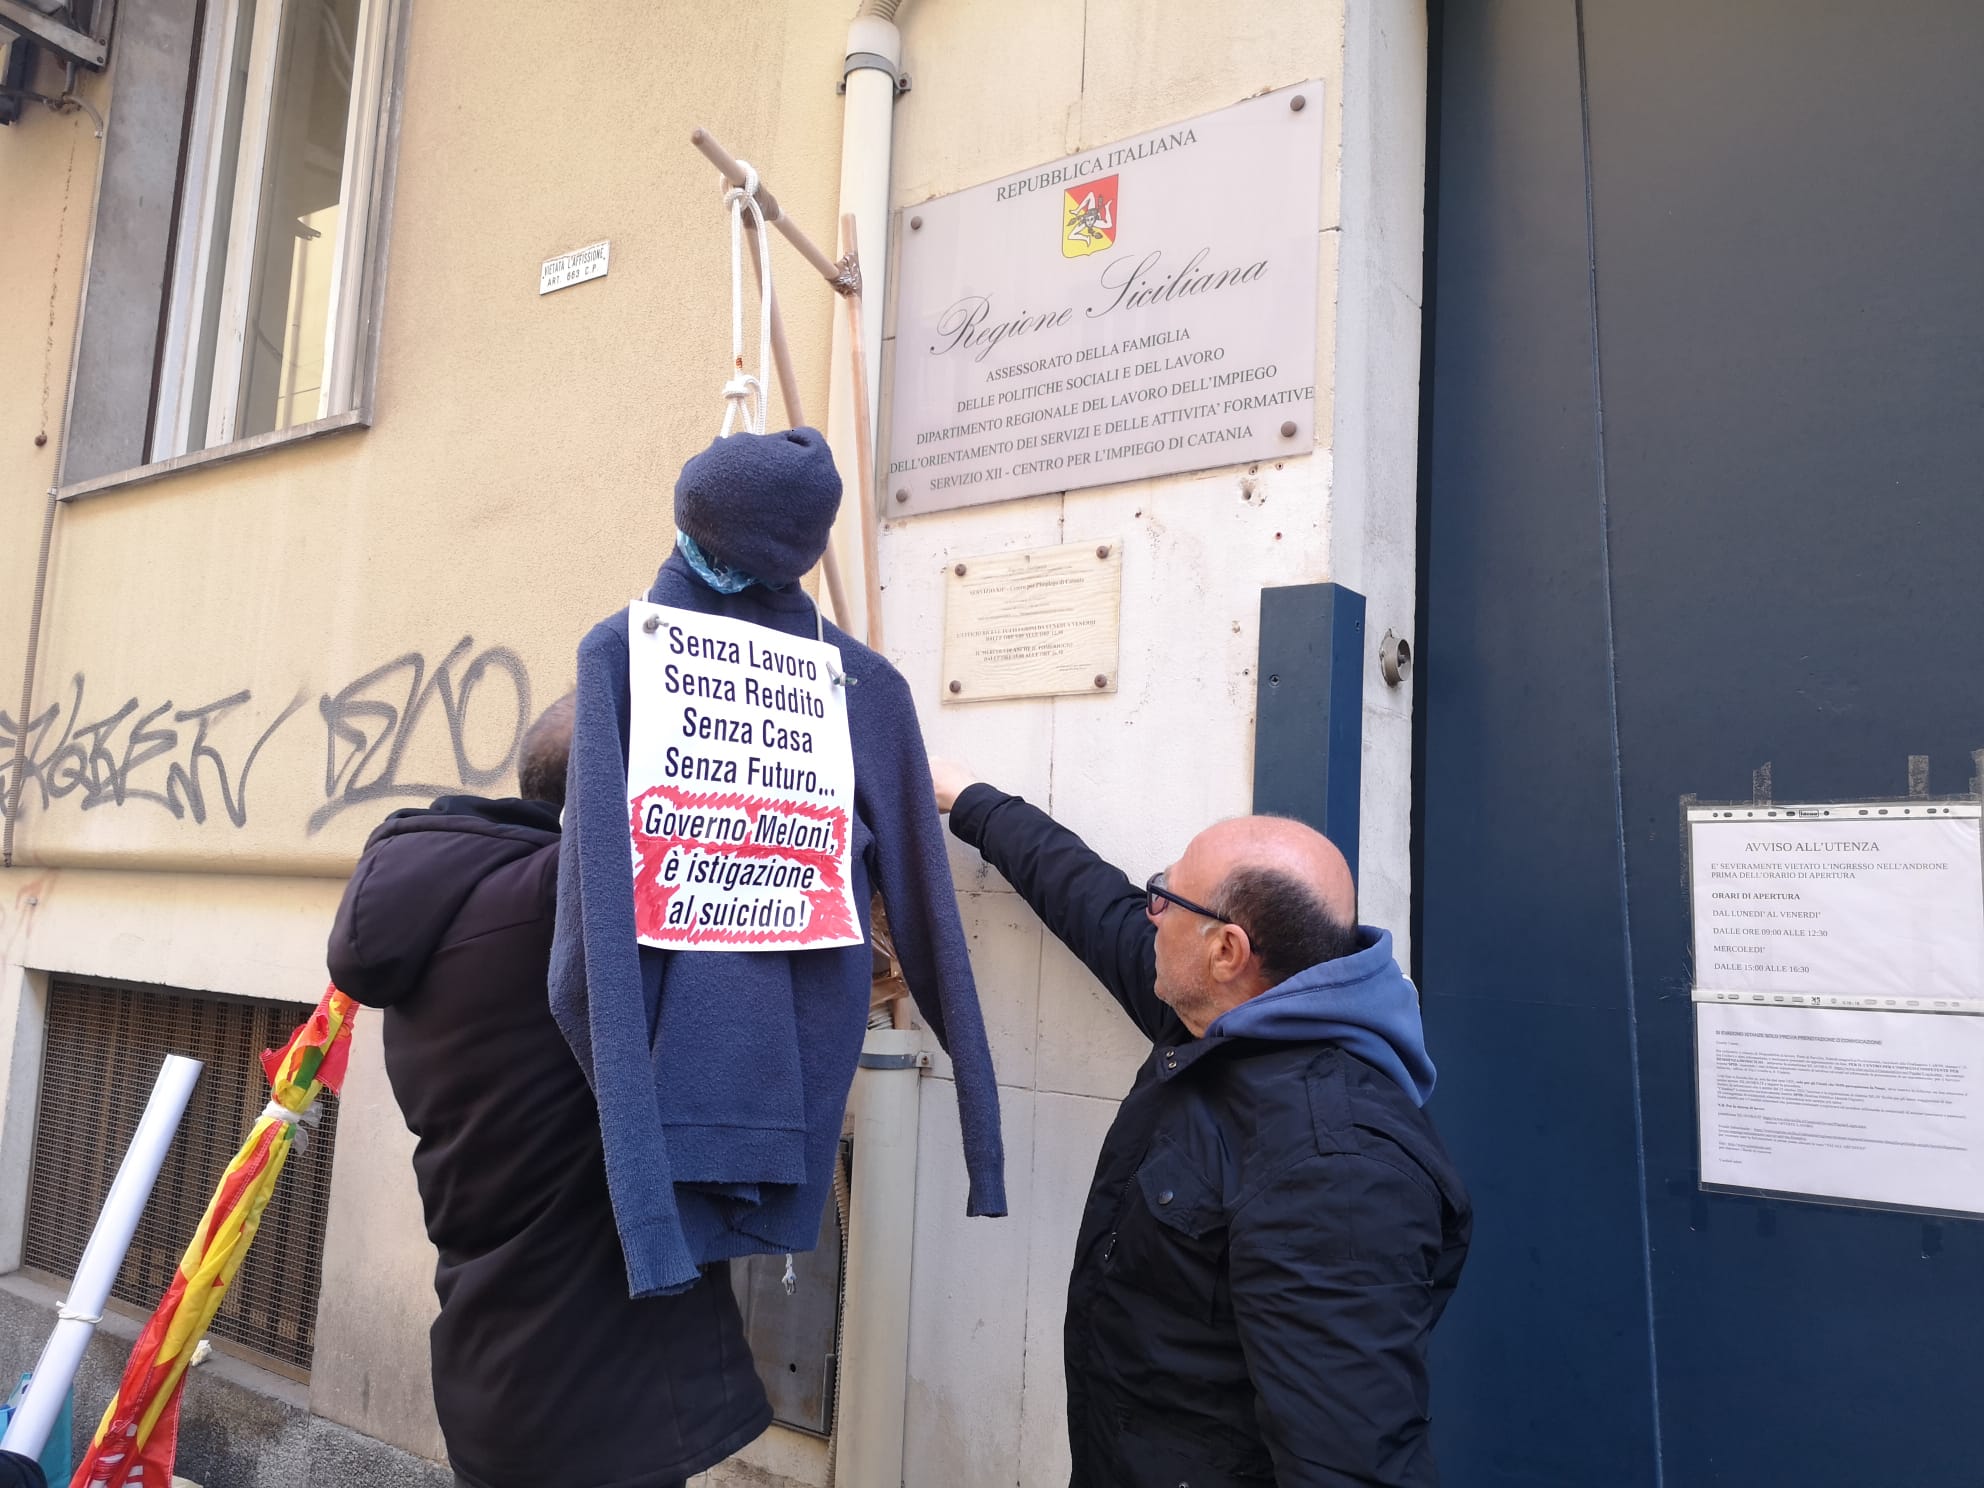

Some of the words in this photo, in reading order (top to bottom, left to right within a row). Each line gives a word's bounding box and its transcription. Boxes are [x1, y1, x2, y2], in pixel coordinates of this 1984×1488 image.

[996, 157, 1103, 202] REPUBBLICA
[1108, 128, 1197, 168] ITALIANA
[567, 269, 580, 281] 663
[930, 292, 1073, 363] Regione
[1085, 247, 1269, 318] Siciliana
[957, 395, 995, 413] DELLE
[998, 380, 1063, 405] POLITICHE
[1066, 368, 1119, 391] SOCIALI
[1123, 367, 1131, 379] E
[1134, 361, 1162, 376] DEL
[1165, 347, 1225, 371] LAVORO
[986, 353, 1072, 382] ASSESSORATO
[1076, 344, 1119, 363] DELLA
[1123, 328, 1190, 353] FAMIGLIA
[889, 441, 1014, 474] DELL'ORIENTAMENTO
[1016, 438, 1037, 451] DEI
[1040, 426, 1090, 446] SERVIZI
[1093, 424, 1101, 437] E
[1105, 415, 1149, 435] DELLE
[1151, 402, 1220, 426] ATTIVITA'
[1224, 386, 1314, 414] FORMATIVE
[917, 418, 1003, 445] DIPARTIMENTO
[1006, 403, 1079, 428] REGIONALE
[1082, 397, 1108, 413] DEL
[1111, 385, 1168, 407] LAVORO
[1171, 364, 1277, 396] DELL'IMPIEGO
[930, 471, 982, 491] SERVIZIO
[985, 467, 1002, 481] XII
[1012, 456, 1063, 476] CENTRO
[1067, 452, 1091, 467] PER
[1094, 440, 1165, 463] L'IMPIEGO
[1168, 436, 1183, 451] DI
[1187, 425, 1253, 447] CATANIA
[668, 626, 740, 664] Senza
[749, 640, 817, 681] Lavoro
[664, 664, 736, 702] Senza
[745, 678, 824, 719] Reddito
[682, 707, 753, 744] Senza
[762, 719, 813, 754] Casa
[664, 747, 737, 784] Senza
[747, 757, 836, 797] Futuro...
[645, 804, 747, 842] Governo
[754, 815, 836, 854] Meloni,
[1745, 842, 1792, 852] AVVISO
[1795, 841, 1880, 852] ALL'UTENZA
[664, 850, 680, 882] è
[686, 854, 814, 891] istigazione
[668, 895, 695, 927] al
[699, 899, 806, 928] suicidio!
[1712, 927, 1740, 935] DALLE
[1761, 928, 1781, 936] 09:00
[1783, 929, 1806, 937] ALLE
[1808, 929, 1828, 937] 12:30
[1714, 963, 1742, 971] DALLE
